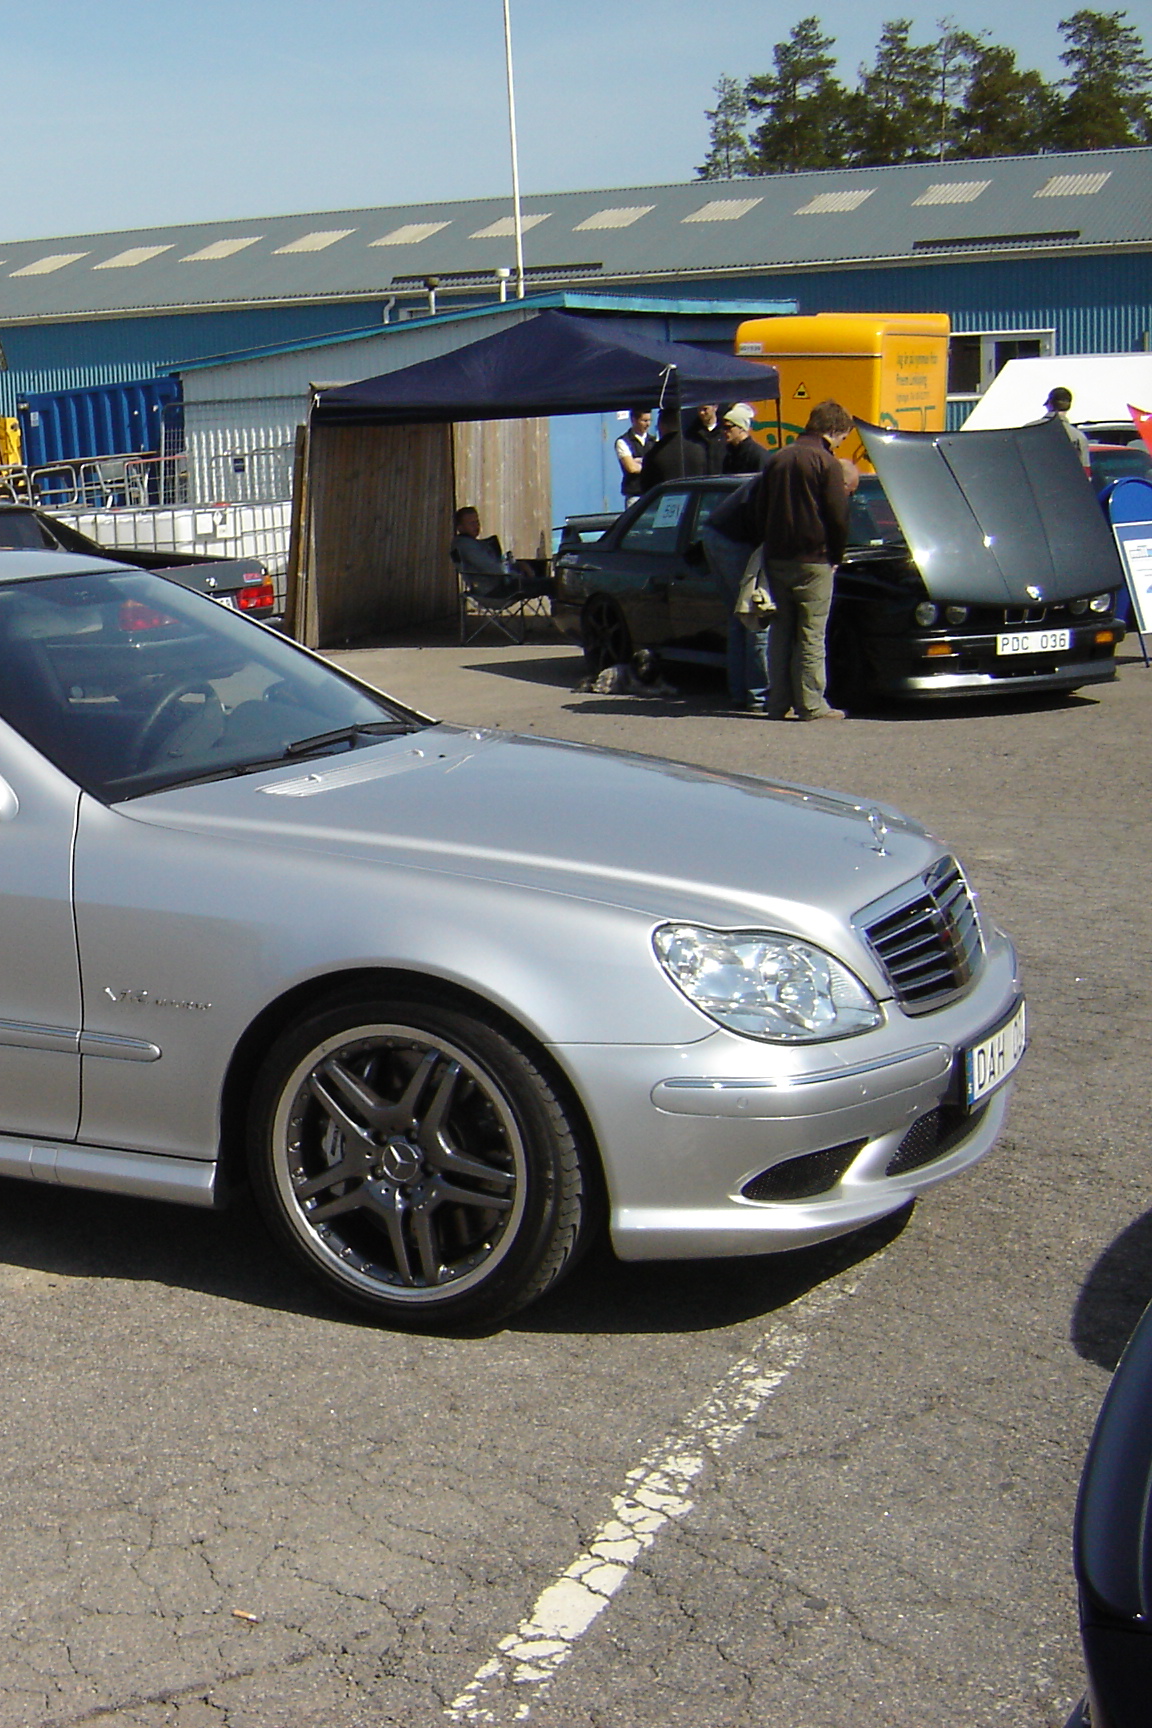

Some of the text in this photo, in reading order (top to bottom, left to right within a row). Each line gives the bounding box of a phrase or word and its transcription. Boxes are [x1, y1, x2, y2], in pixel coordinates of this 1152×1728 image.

[1001, 632, 1066, 652] PDC 036
[977, 1031, 1005, 1090] DAH
